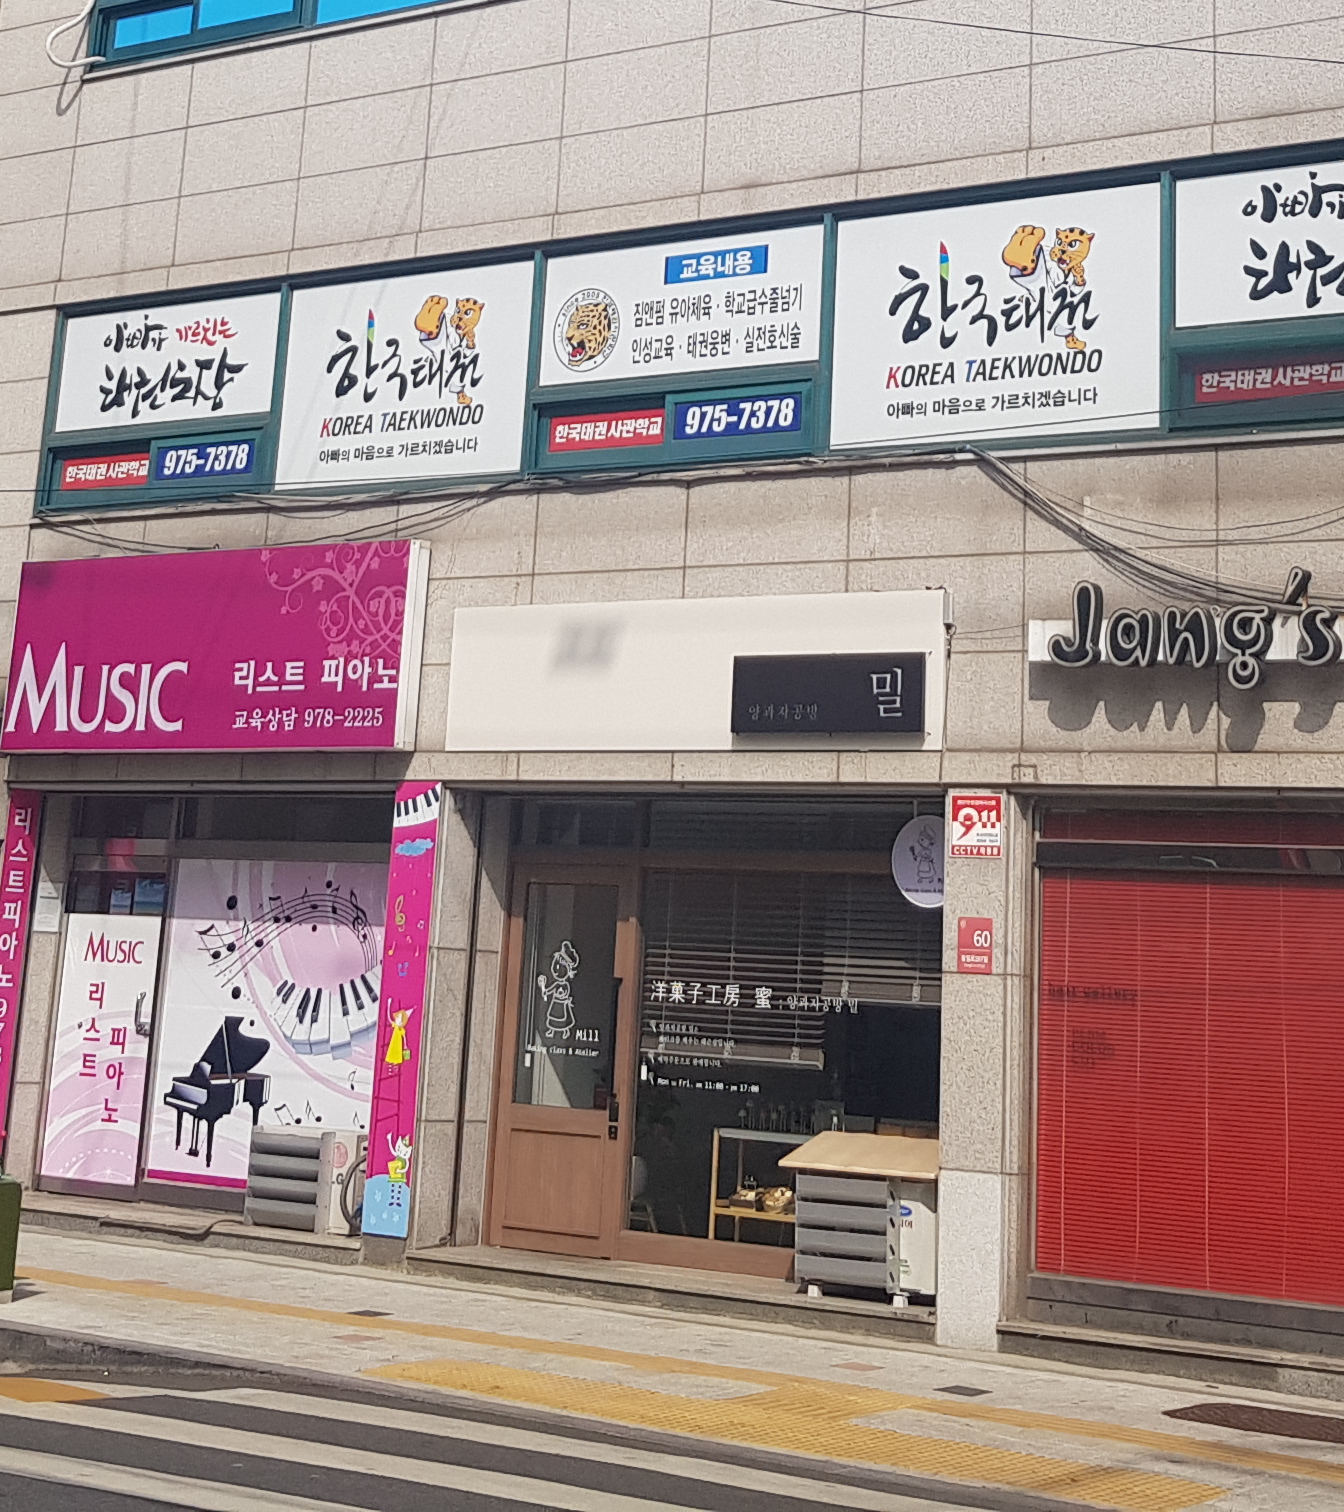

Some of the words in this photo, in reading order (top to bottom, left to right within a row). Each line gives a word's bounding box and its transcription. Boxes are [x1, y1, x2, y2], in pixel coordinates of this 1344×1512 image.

[679, 250, 753, 279] 교육내용
[633, 298, 665, 328] 짐앤펌
[668, 293, 713, 325] 유아체육
[724, 282, 803, 318] 학교급수줄넘기
[887, 241, 1101, 351] 한국태권
[175, 317, 239, 346] 가르치는
[631, 334, 675, 365] 인성교육
[686, 328, 732, 359] 태권웅변
[743, 321, 802, 354] 실전호신술
[326, 309, 484, 403] 한국태권
[885, 362, 956, 390] KOREA
[964, 348, 1103, 383] TAEKWONDO
[684, 397, 795, 435] 975-7378
[885, 397, 928, 419] 아빠의
[931, 393, 987, 417] 마음으로
[990, 385, 1098, 412] 가르치겠습니다
[319, 410, 374, 438] KOREA
[379, 403, 484, 435] TAEKWONDO
[163, 443, 249, 476] 975-7378
[319, 447, 351, 464] 아빠의
[353, 443, 395, 462] 마음으로
[397, 438, 479, 461] 가르치겠습니다
[1050, 566, 1343, 689] Jang's
[5, 641, 190, 735] MUSIC
[232, 658, 306, 694] 리스트
[320, 656, 399, 691] 피아노
[870, 667, 903, 718] 밀
[231, 705, 298, 732] 교육상담
[304, 705, 384, 729] 978-2225
[83, 930, 145, 965] MUSIC
[973, 930, 991, 947] 60
[650, 979, 741, 1007] 洋菓子工房
[754, 986, 773, 1009] 蜜
[78, 981, 106, 1078] 리스트
[101, 1026, 128, 1124] 피아노
[575, 1028, 600, 1042] Mill
